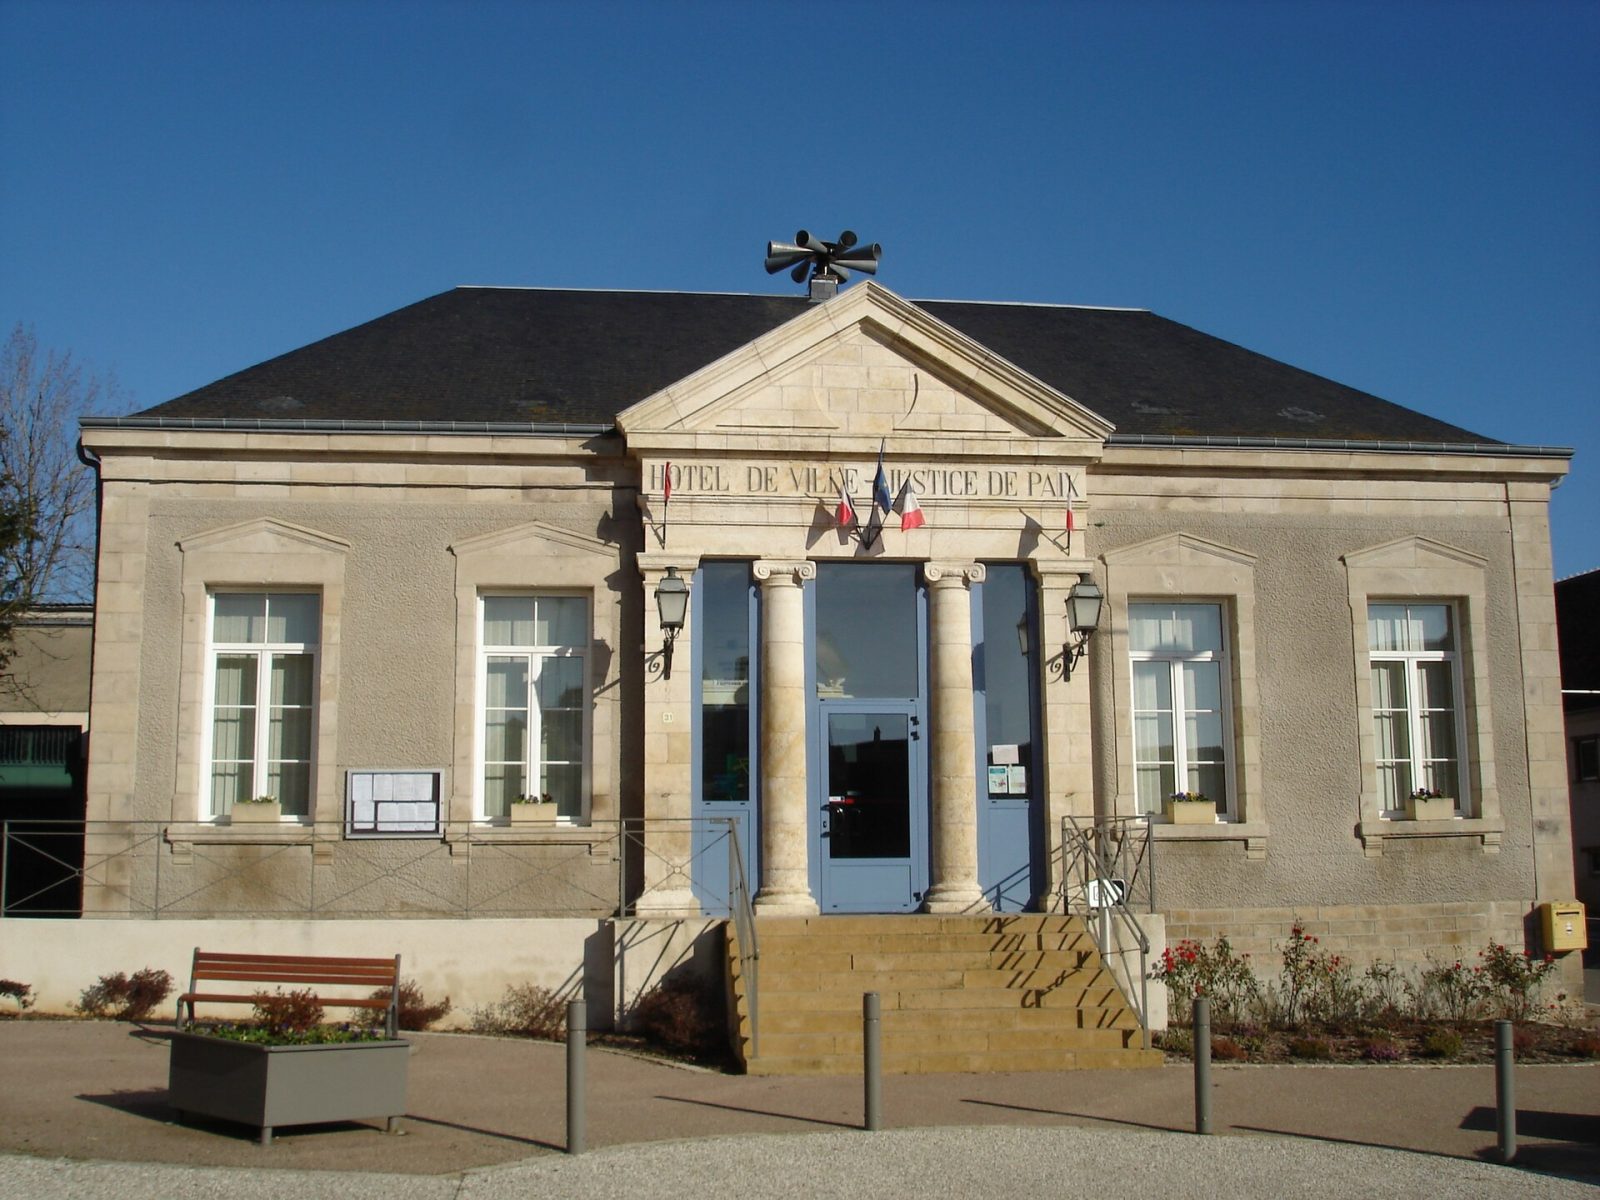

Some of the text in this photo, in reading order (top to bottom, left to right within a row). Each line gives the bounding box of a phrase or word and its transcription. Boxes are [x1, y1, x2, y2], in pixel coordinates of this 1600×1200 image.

[649, 464, 730, 491] HOTEL
[747, 466, 778, 492] DE
[789, 467, 858, 494] VILLE
[988, 470, 1018, 497] DE
[1027, 471, 1079, 498] PAIX
